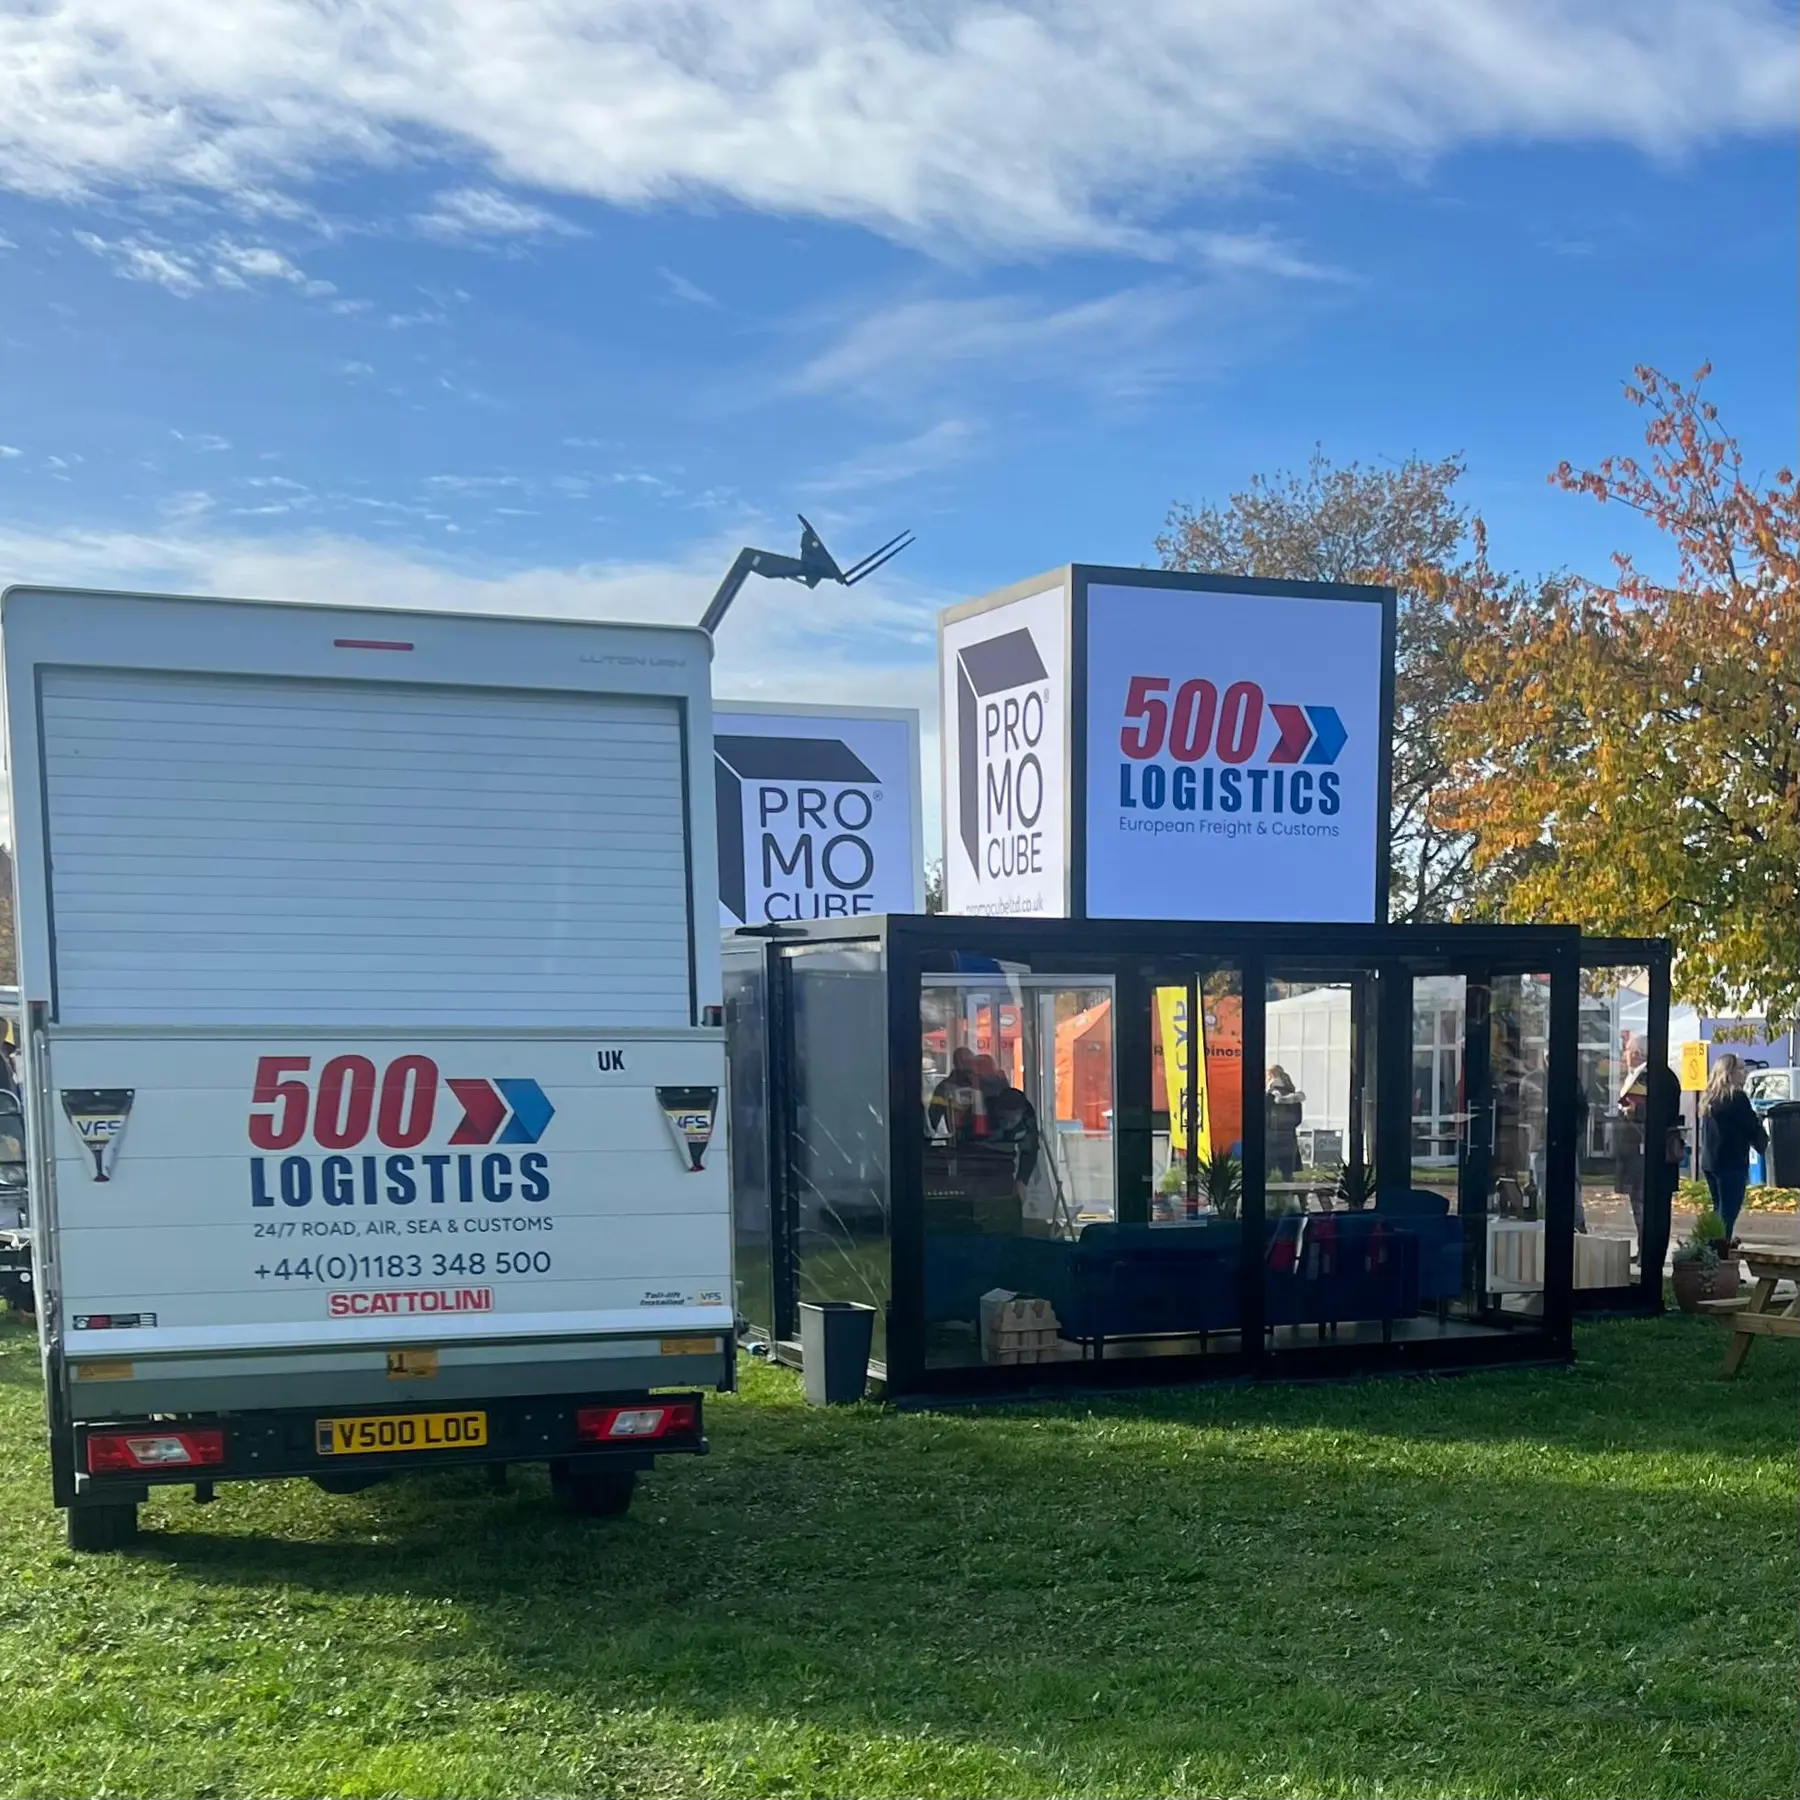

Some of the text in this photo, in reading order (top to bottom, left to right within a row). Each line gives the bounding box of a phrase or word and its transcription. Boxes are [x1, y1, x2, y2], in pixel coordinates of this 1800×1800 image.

[986, 691, 1043, 757] PRO
[1120, 676, 1264, 764] 500
[759, 787, 872, 830] PRO
[987, 752, 1043, 834] MO
[1120, 763, 1340, 815] LOGISTICS
[1119, 816, 1340, 838] European Freight & Customs
[762, 832, 874, 890] MO
[988, 832, 1042, 879] CUBE
[597, 1050, 625, 1071] UK
[248, 1054, 439, 1150] 500
[76, 1120, 122, 1136] VFS
[250, 1152, 550, 1207] LOGISTICS
[254, 1216, 554, 1238] 24/7 ROAD, AIR, SEA & CUSTOMS
[254, 1251, 551, 1284] +44(0)1183 348 500
[330, 1289, 491, 1315] SCATTOLINI
[339, 1416, 480, 1448] V500 LOG
